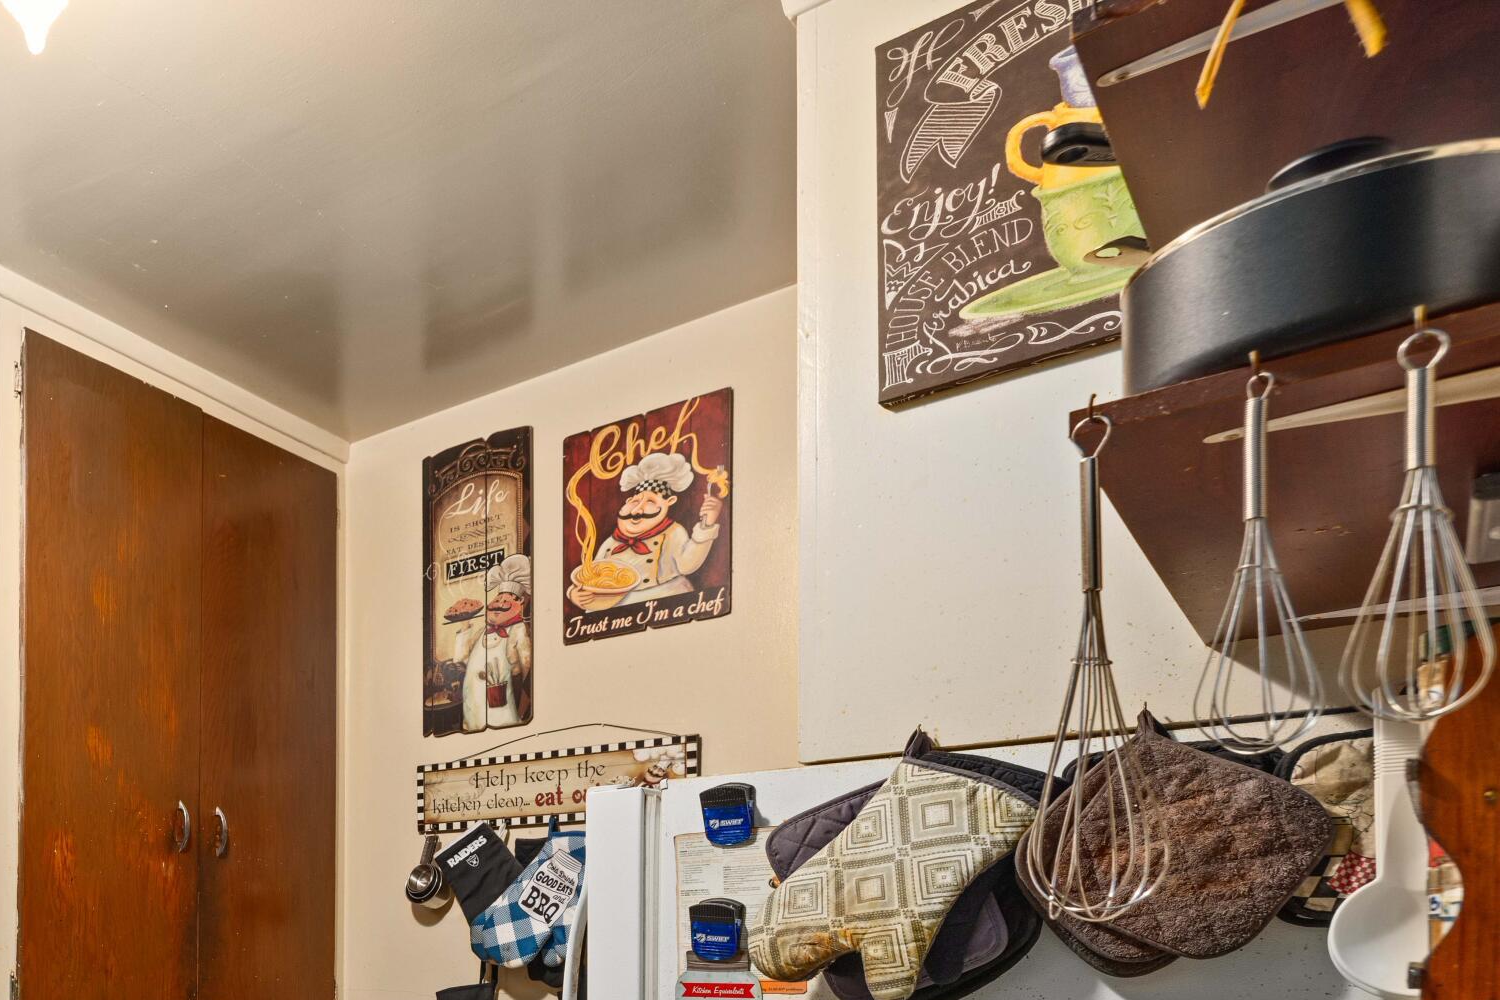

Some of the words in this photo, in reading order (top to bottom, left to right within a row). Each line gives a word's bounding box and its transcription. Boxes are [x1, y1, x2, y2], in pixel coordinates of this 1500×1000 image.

[881, 162, 1000, 241] Enjoy!
[886, 270, 946, 348] HOUSE
[941, 217, 1034, 275] BLEND
[588, 397, 698, 480] Chef
[443, 479, 510, 520] Life
[450, 525, 461, 533] IS
[464, 514, 501, 529] SHORT
[446, 546, 464, 555] EAT
[467, 534, 510, 550] DESSERT
[448, 550, 504, 577] FIRST
[566, 615, 608, 639] Trust
[611, 615, 633, 630] me
[636, 600, 669, 624] I'm
[672, 606, 684, 618] a
[687, 586, 725, 616] chef
[473, 769, 517, 792] Help
[524, 766, 569, 788] keep
[576, 760, 607, 783] the
[432, 796, 482, 815] kitchen
[535, 785, 564, 807] eat
[719, 818, 744, 827] SWIFT
[446, 835, 488, 869] RAIDERS
[535, 870, 556, 890] GOOD
[555, 880, 574, 896] EATS
[552, 893, 567, 905] and
[706, 935, 731, 943] SWIFT
[692, 985, 712, 995] Kitchen
[713, 985, 745, 996] Equivalents
